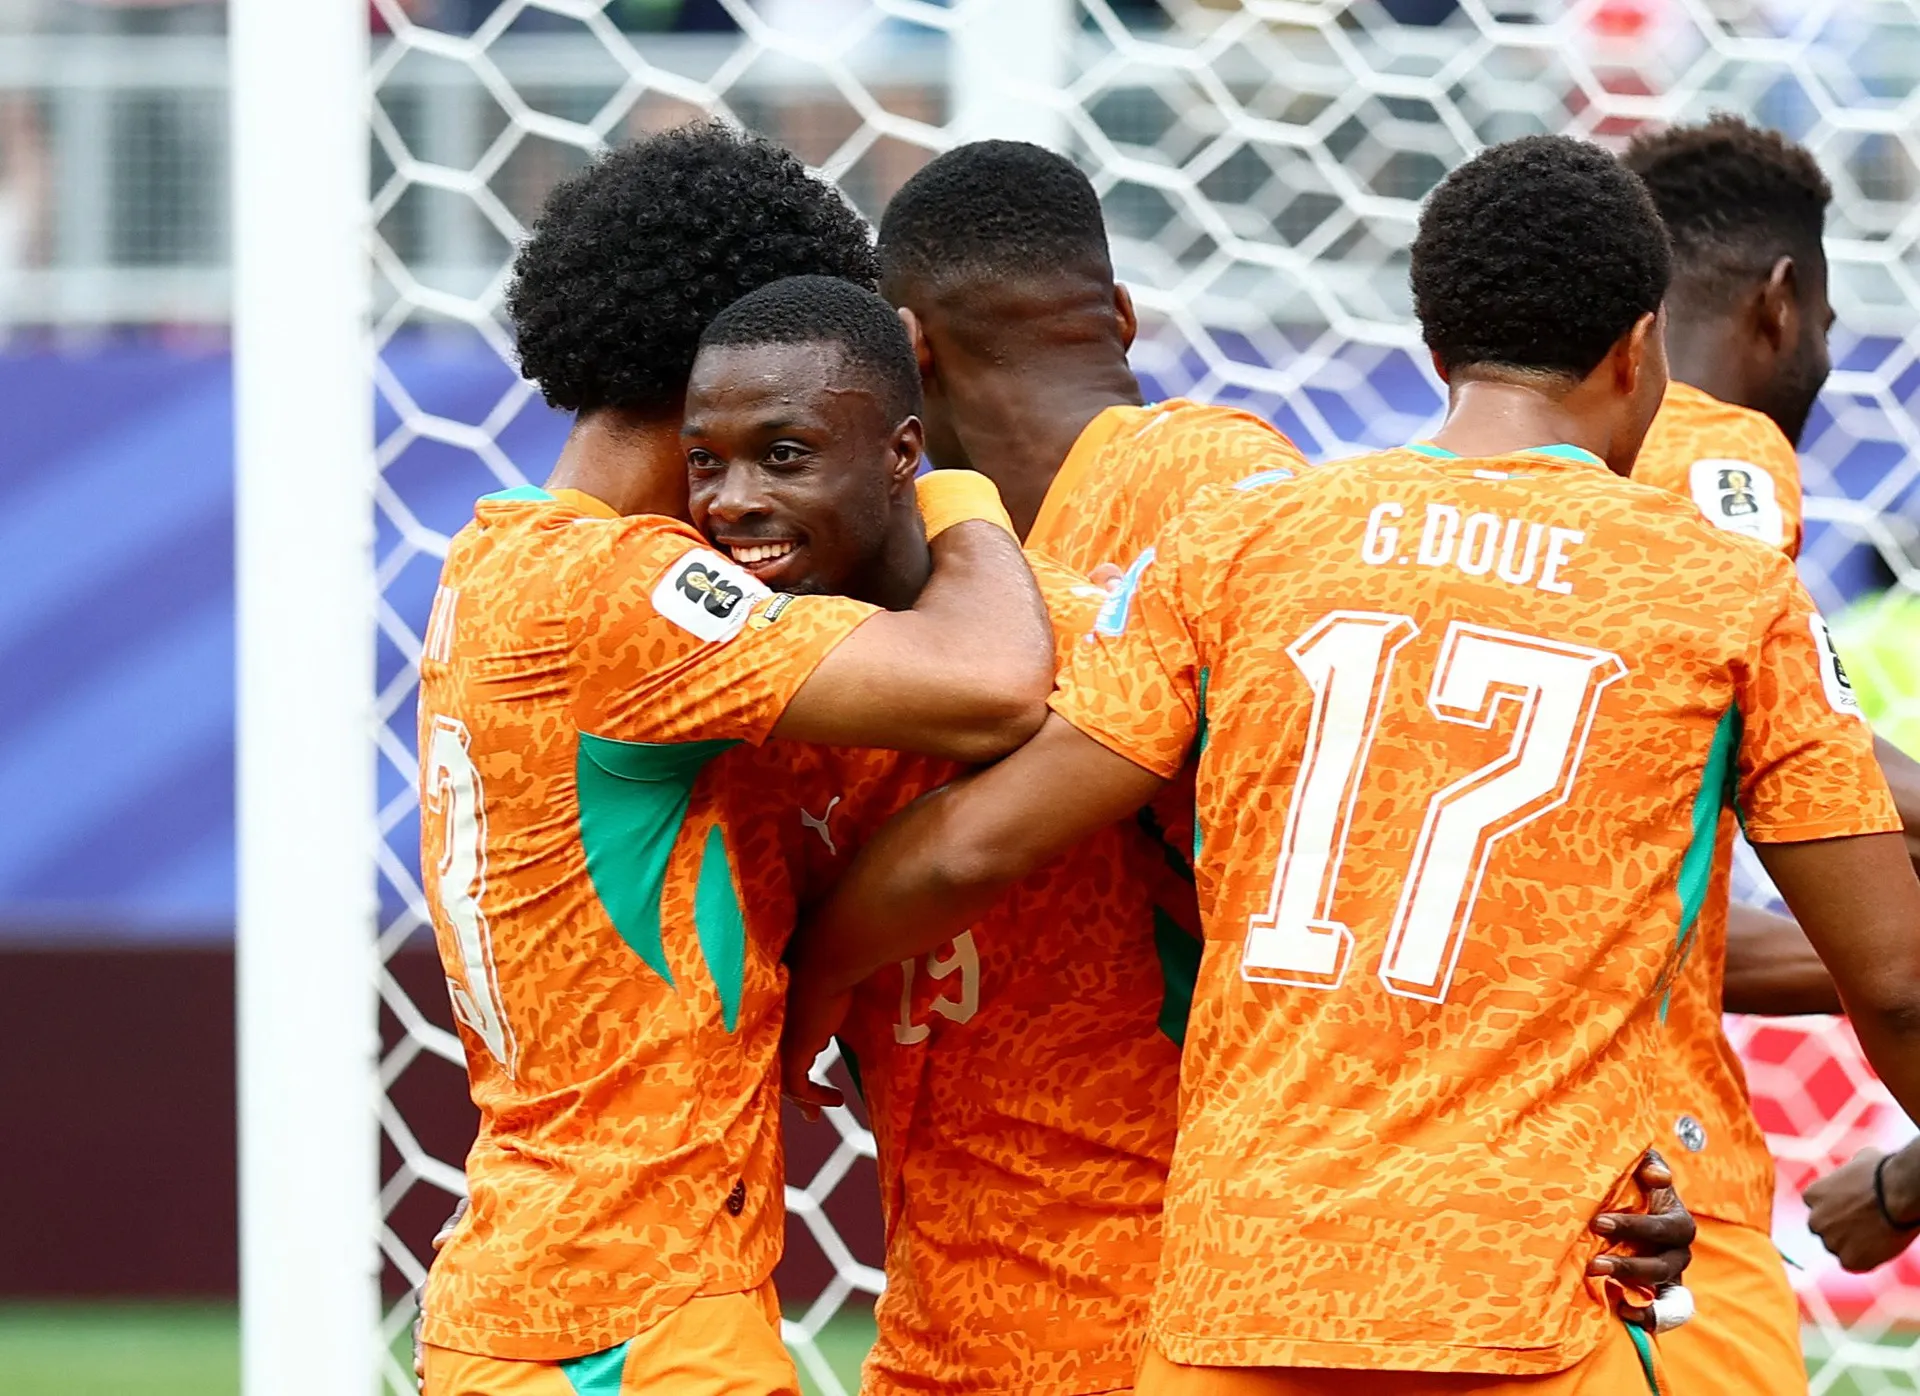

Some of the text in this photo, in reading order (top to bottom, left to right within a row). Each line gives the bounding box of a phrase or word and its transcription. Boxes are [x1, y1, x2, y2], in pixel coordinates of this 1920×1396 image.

[1361, 502, 1585, 595] G.DOUE
[1240, 610, 1629, 1005] 17
[893, 929, 980, 1044] 19
